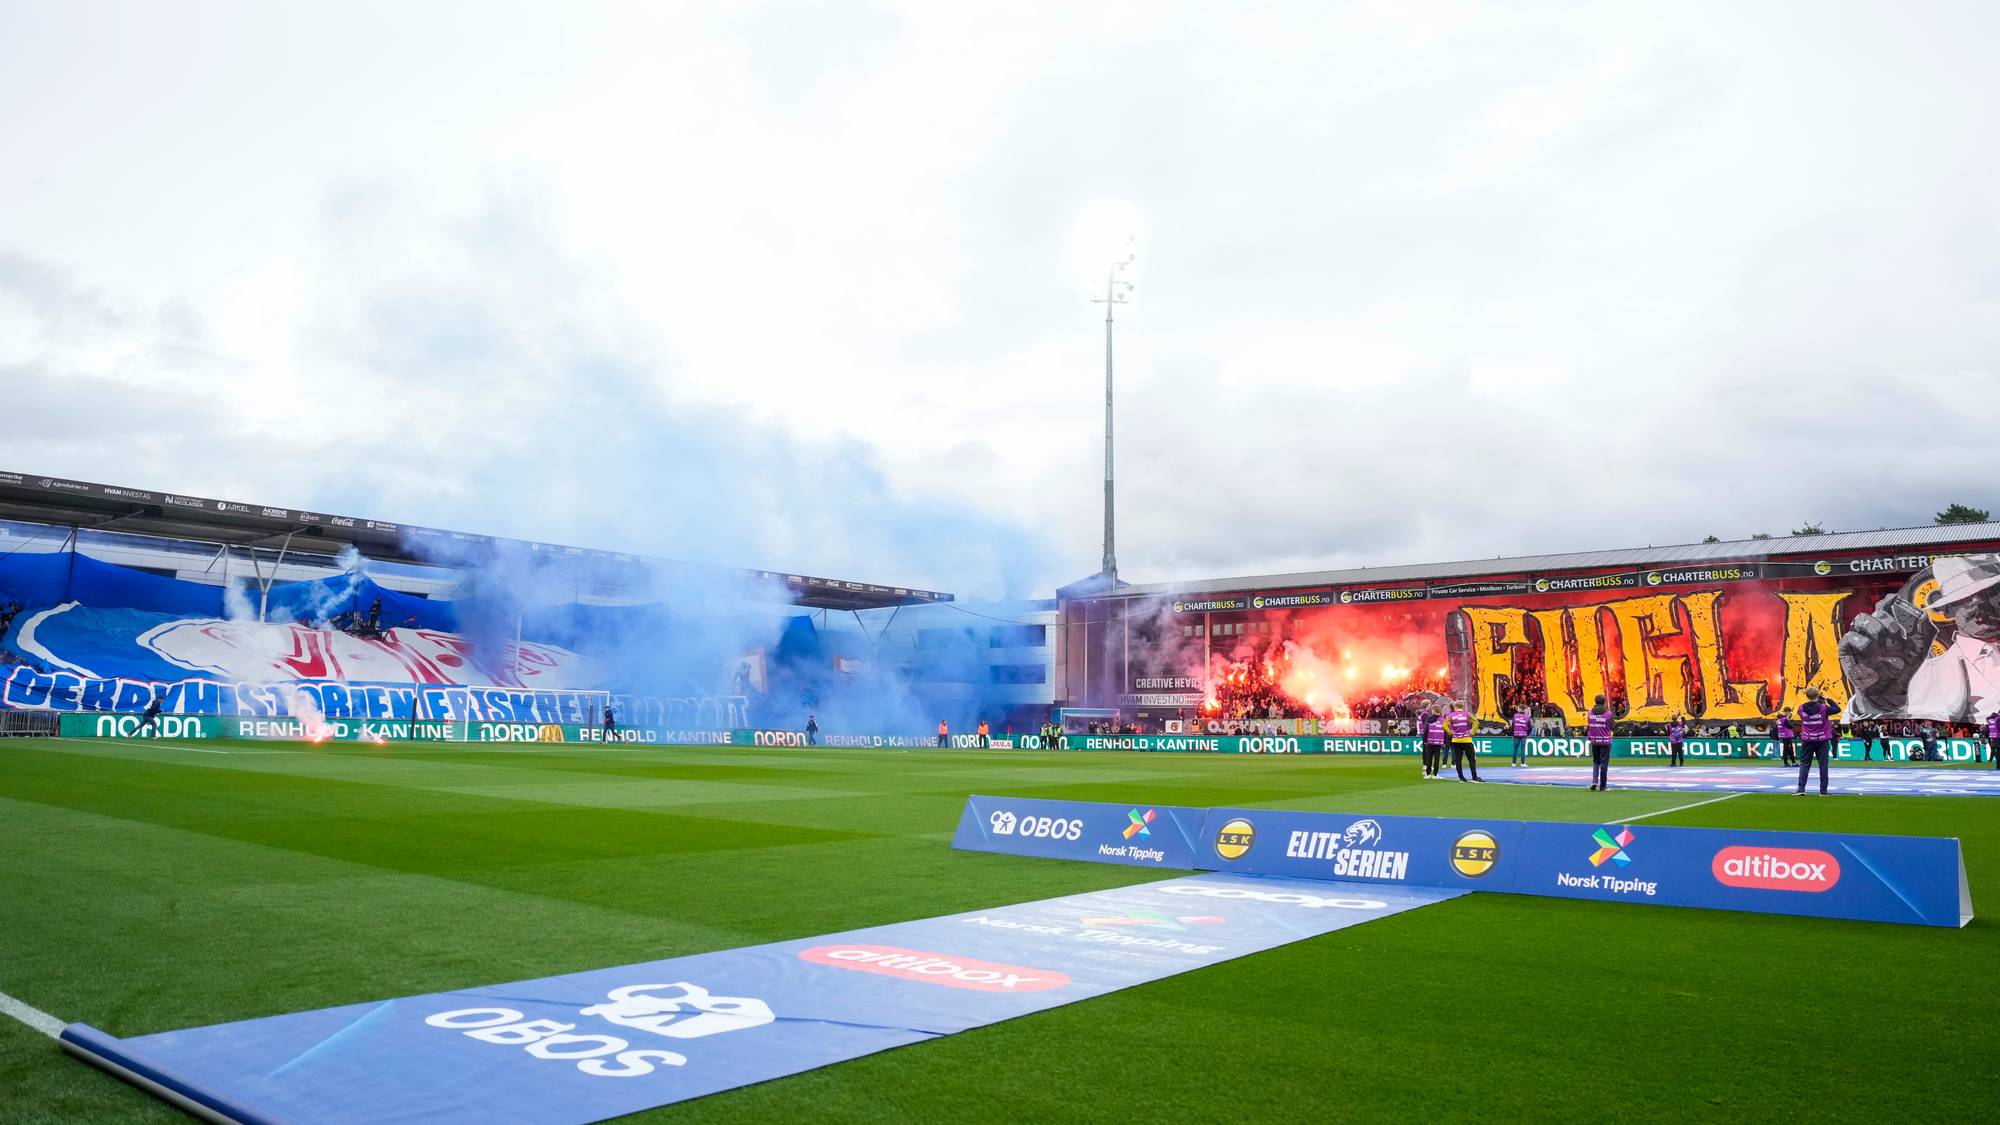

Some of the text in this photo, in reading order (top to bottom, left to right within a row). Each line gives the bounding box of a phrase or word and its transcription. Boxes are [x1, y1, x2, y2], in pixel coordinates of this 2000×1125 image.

[104, 487, 122, 496] HVAM
[122, 489, 142, 498] INVEST
[1662, 568, 1754, 584] CHARTERBUSS.no
[1550, 577, 1634, 591] CHARTERBUSS.no
[1265, 595, 1330, 607] CHARTERBUSS.no
[1353, 589, 1424, 601] CHARTERBUSS.no
[1184, 600, 1245, 612] CHARTERBUSS.no
[1136, 677, 1174, 689] CREATIVE
[1120, 695, 1143, 705] HVAM
[666, 730, 732, 744] KANTINE
[1086, 738, 1148, 749] RENHOLD
[1157, 738, 1219, 751] KANTINE
[1324, 740, 1401, 752] RENHOLD
[1020, 815, 1083, 840] OBOS
[1220, 834, 1250, 845] LSK
[1287, 831, 1341, 860] ELITE
[1099, 843, 1164, 862] Norsk Tipping
[1455, 847, 1493, 861] LSK
[1334, 848, 1409, 880] SERIEN
[1724, 855, 1826, 882] altibox
[1557, 872, 1657, 895] Norsk Tipping
[826, 950, 1041, 989] altibox
[425, 1007, 687, 1077] OBOS
